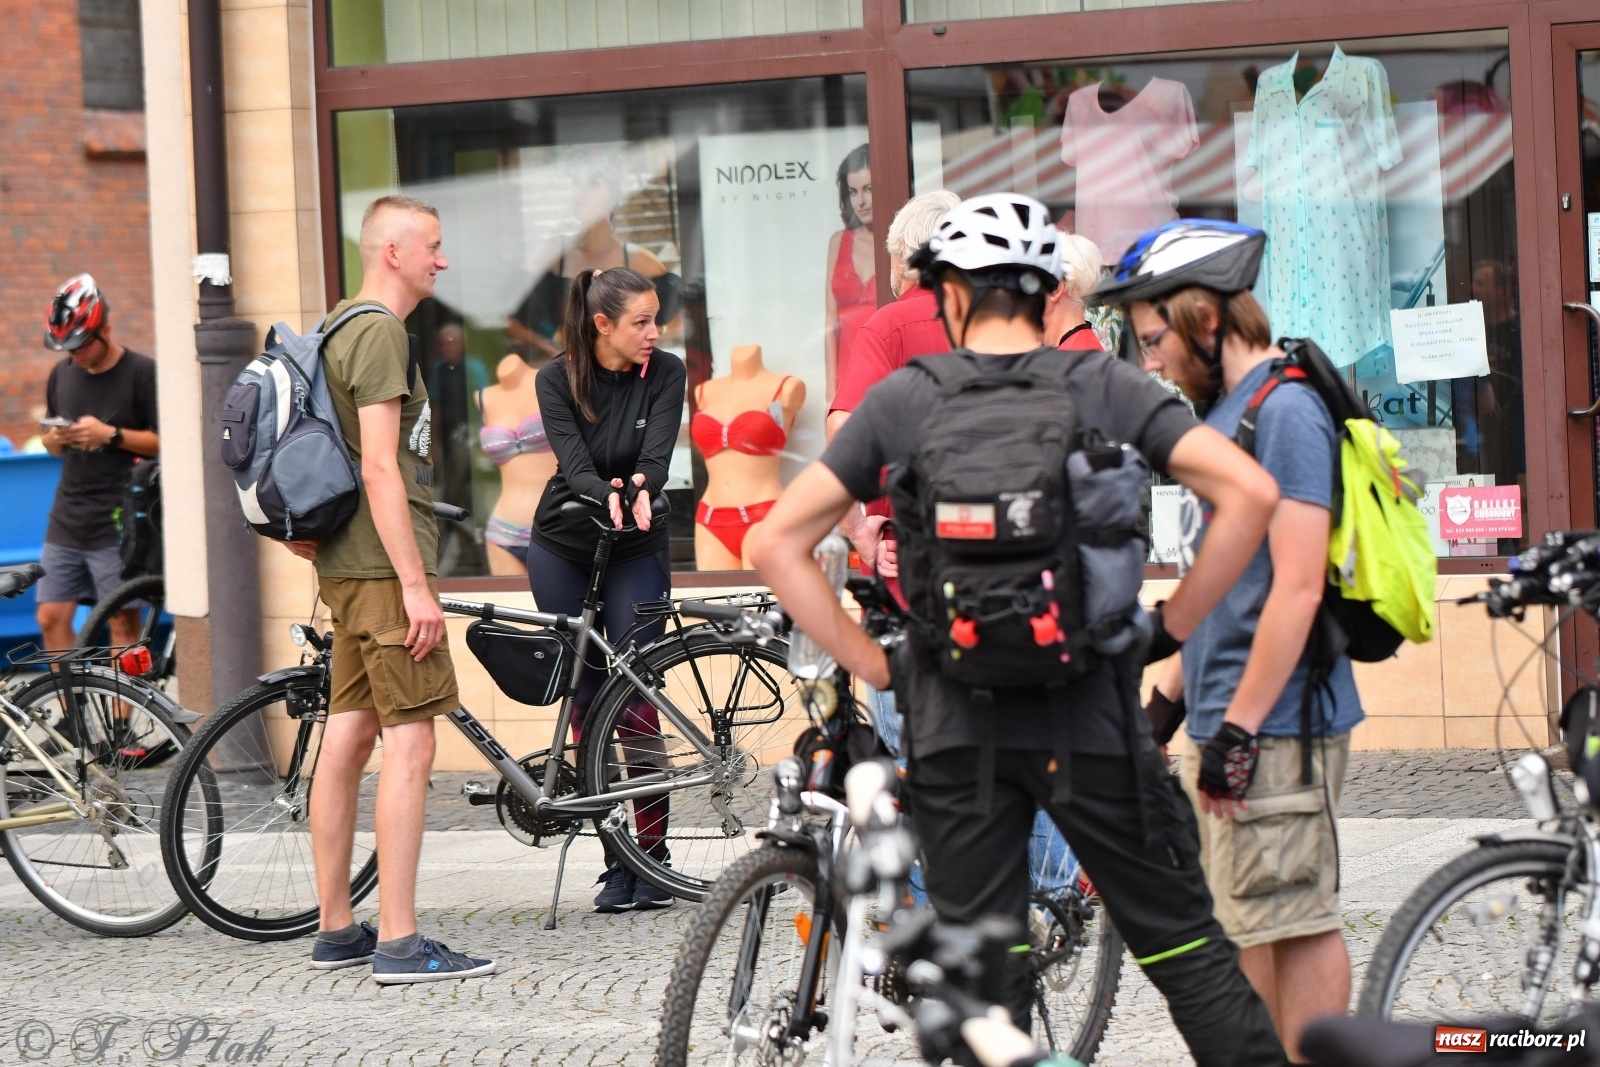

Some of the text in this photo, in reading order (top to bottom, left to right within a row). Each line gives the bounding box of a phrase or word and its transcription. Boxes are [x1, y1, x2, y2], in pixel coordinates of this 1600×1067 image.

[715, 161, 817, 185] NIPPLEX
[720, 190, 808, 204] BY NIGHT
[1473, 499, 1516, 509] OBIEKT
[1473, 509, 1516, 519] CHRONIONY
